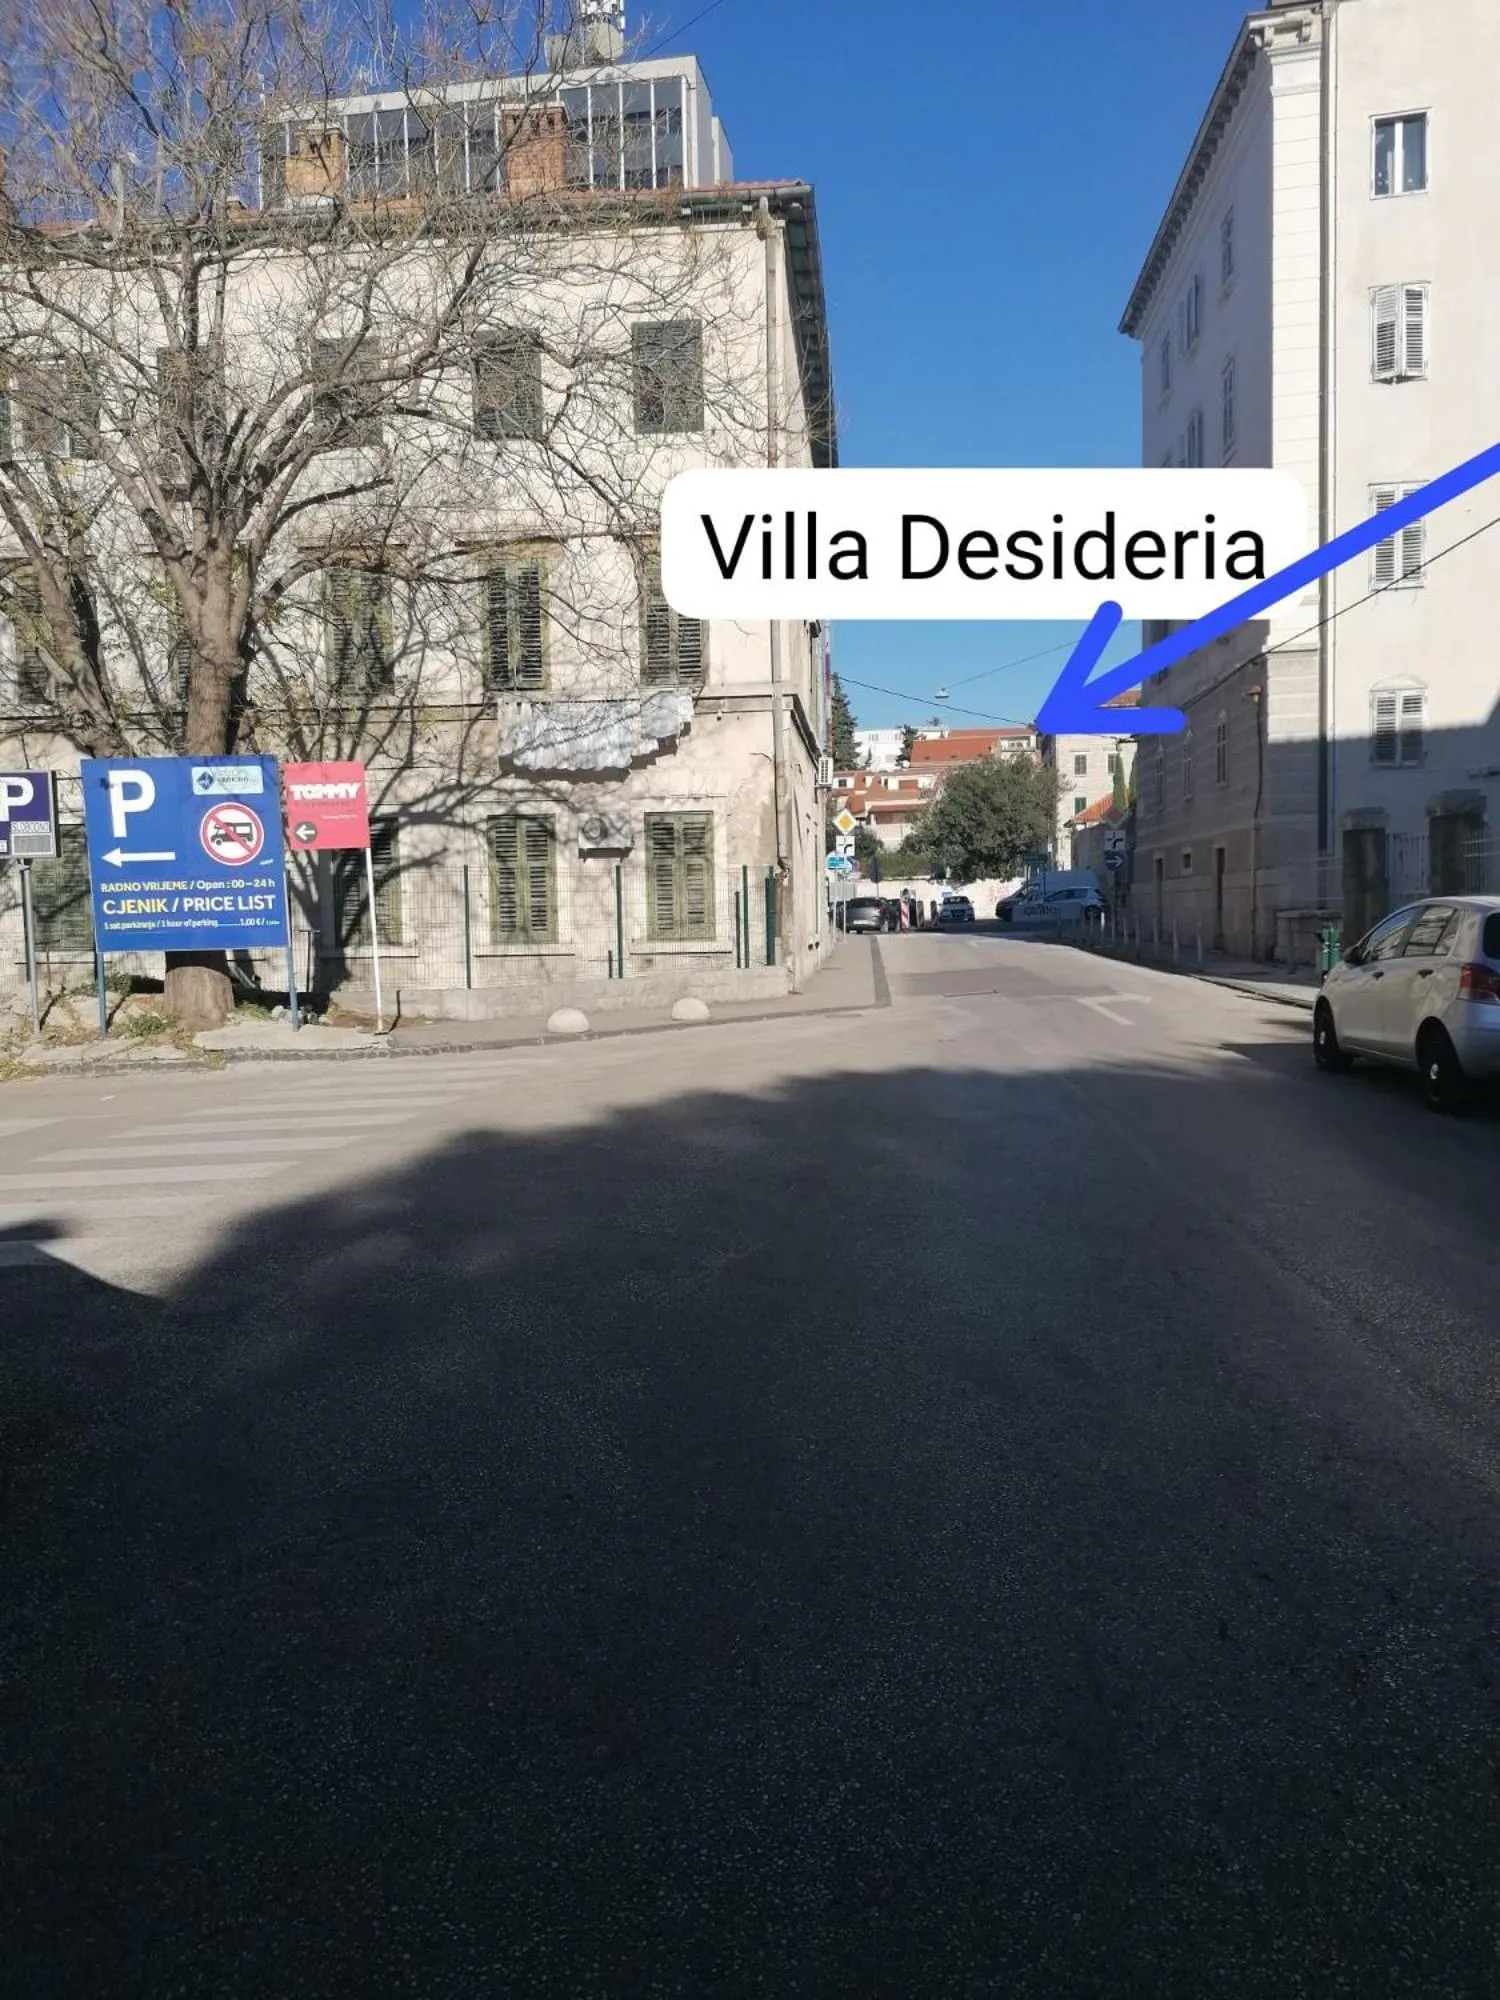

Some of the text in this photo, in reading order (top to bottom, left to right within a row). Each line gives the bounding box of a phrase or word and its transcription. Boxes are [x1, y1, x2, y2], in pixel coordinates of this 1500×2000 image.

[0, 776, 34, 821] P
[289, 783, 362, 801] TOMMY
[107, 769, 156, 838] P
[101, 881, 141, 893] RADNO
[142, 880, 188, 891] VRIJEME
[103, 897, 169, 915] CJENIK
[183, 895, 235, 912] PRICE
[237, 894, 276, 910] LIST
